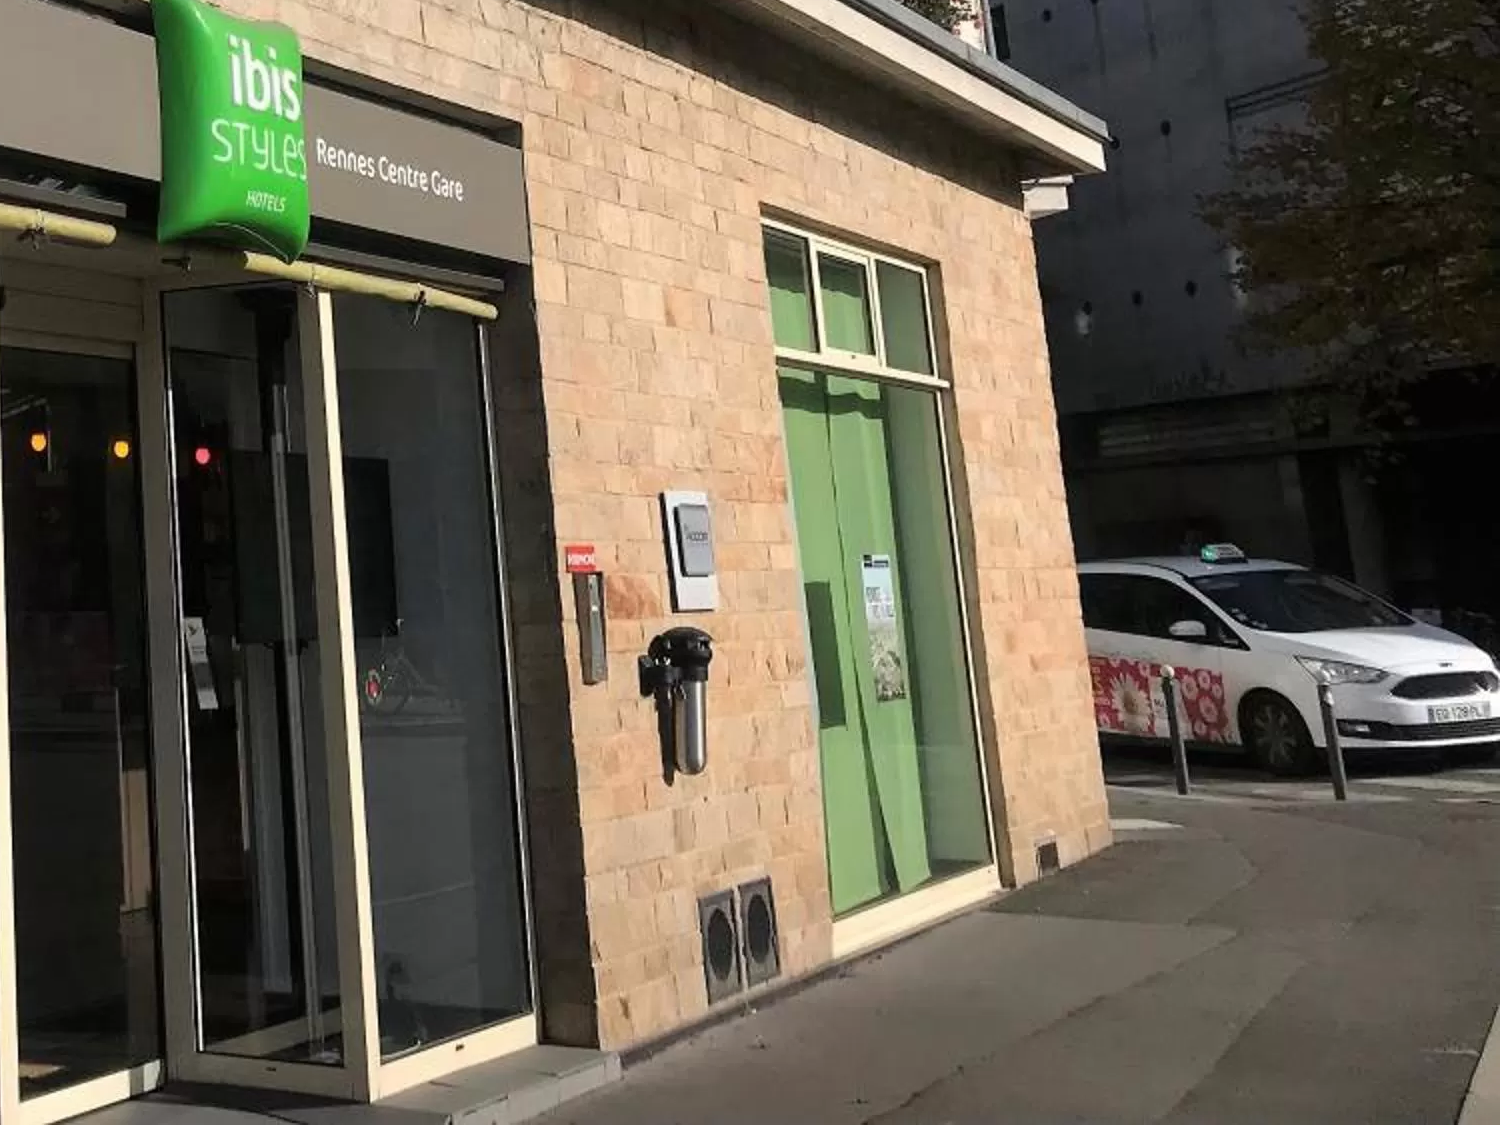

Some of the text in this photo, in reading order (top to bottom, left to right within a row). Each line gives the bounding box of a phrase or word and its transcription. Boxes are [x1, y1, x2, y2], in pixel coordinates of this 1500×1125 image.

[227, 34, 302, 122] ibis
[246, 190, 286, 212] HOTELS
[316, 138, 464, 201] Rennes Centre Gare
